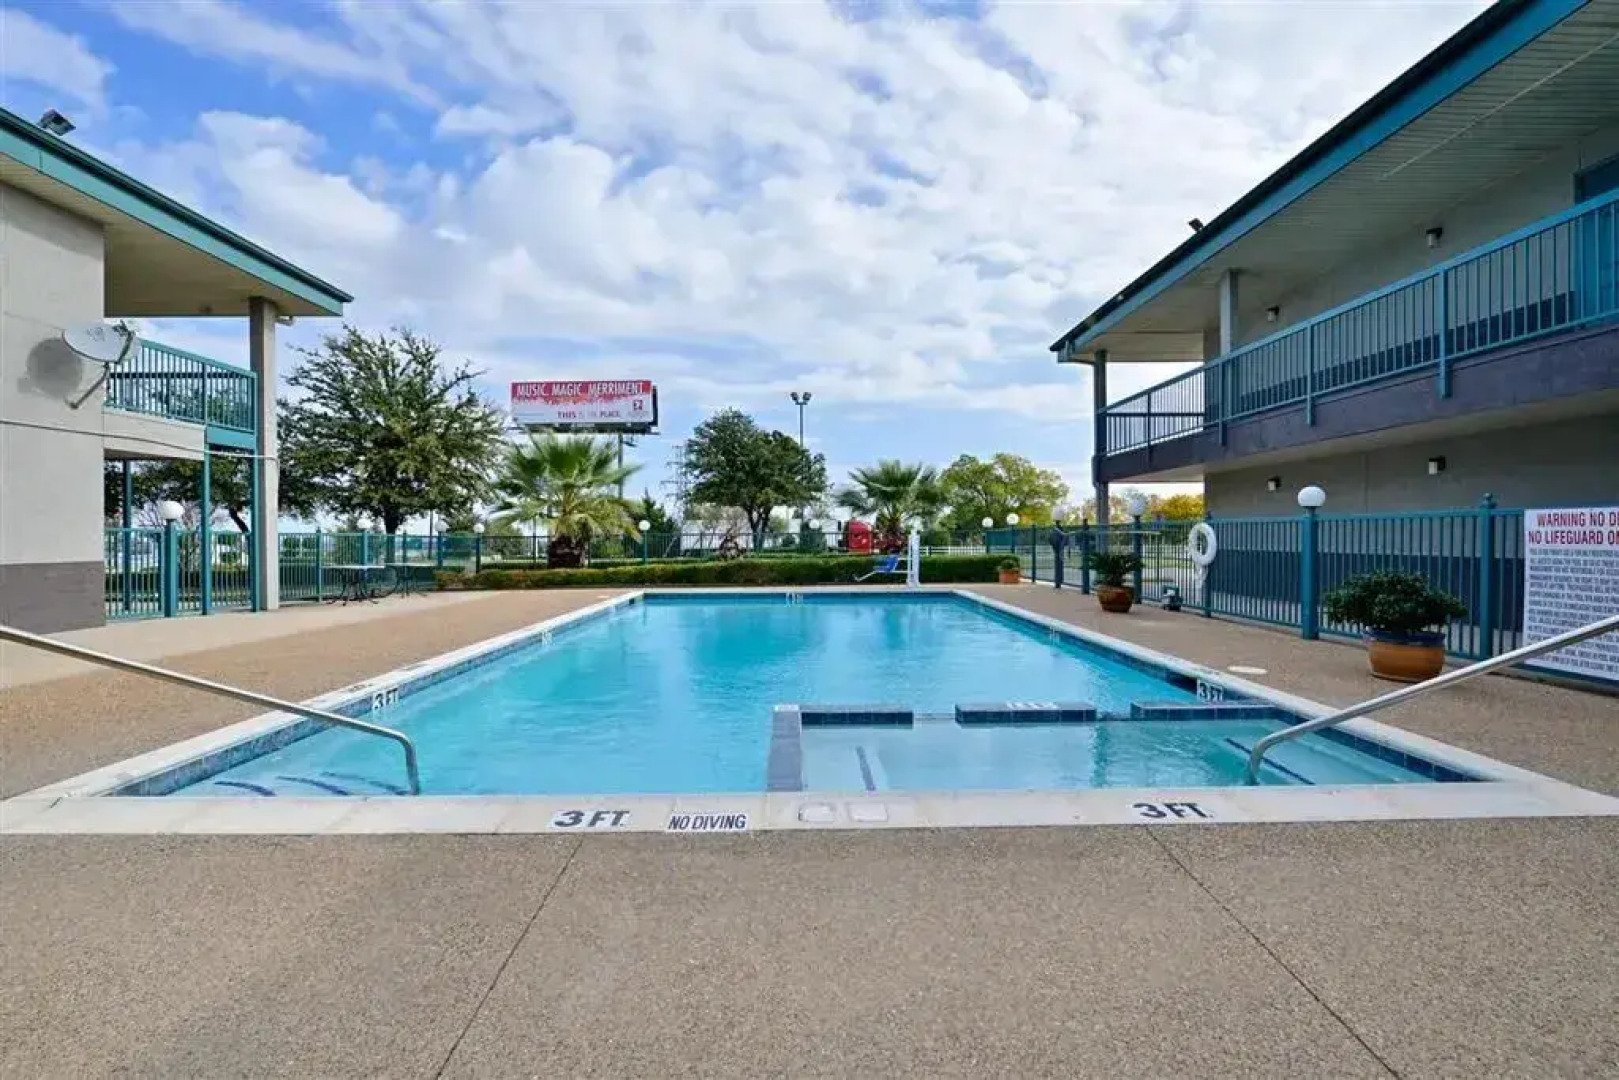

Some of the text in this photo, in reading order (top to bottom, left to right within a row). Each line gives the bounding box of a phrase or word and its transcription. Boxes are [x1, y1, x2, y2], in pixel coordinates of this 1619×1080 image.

[1537, 511, 1586, 527] WARNING
[1590, 511, 1605, 526] NO
[1529, 530, 1542, 545] NO
[1545, 530, 1604, 545] LIFEGUARD
[1132, 802, 1167, 818] 3
[554, 810, 585, 827] 3
[668, 814, 746, 829] NO DIVING
